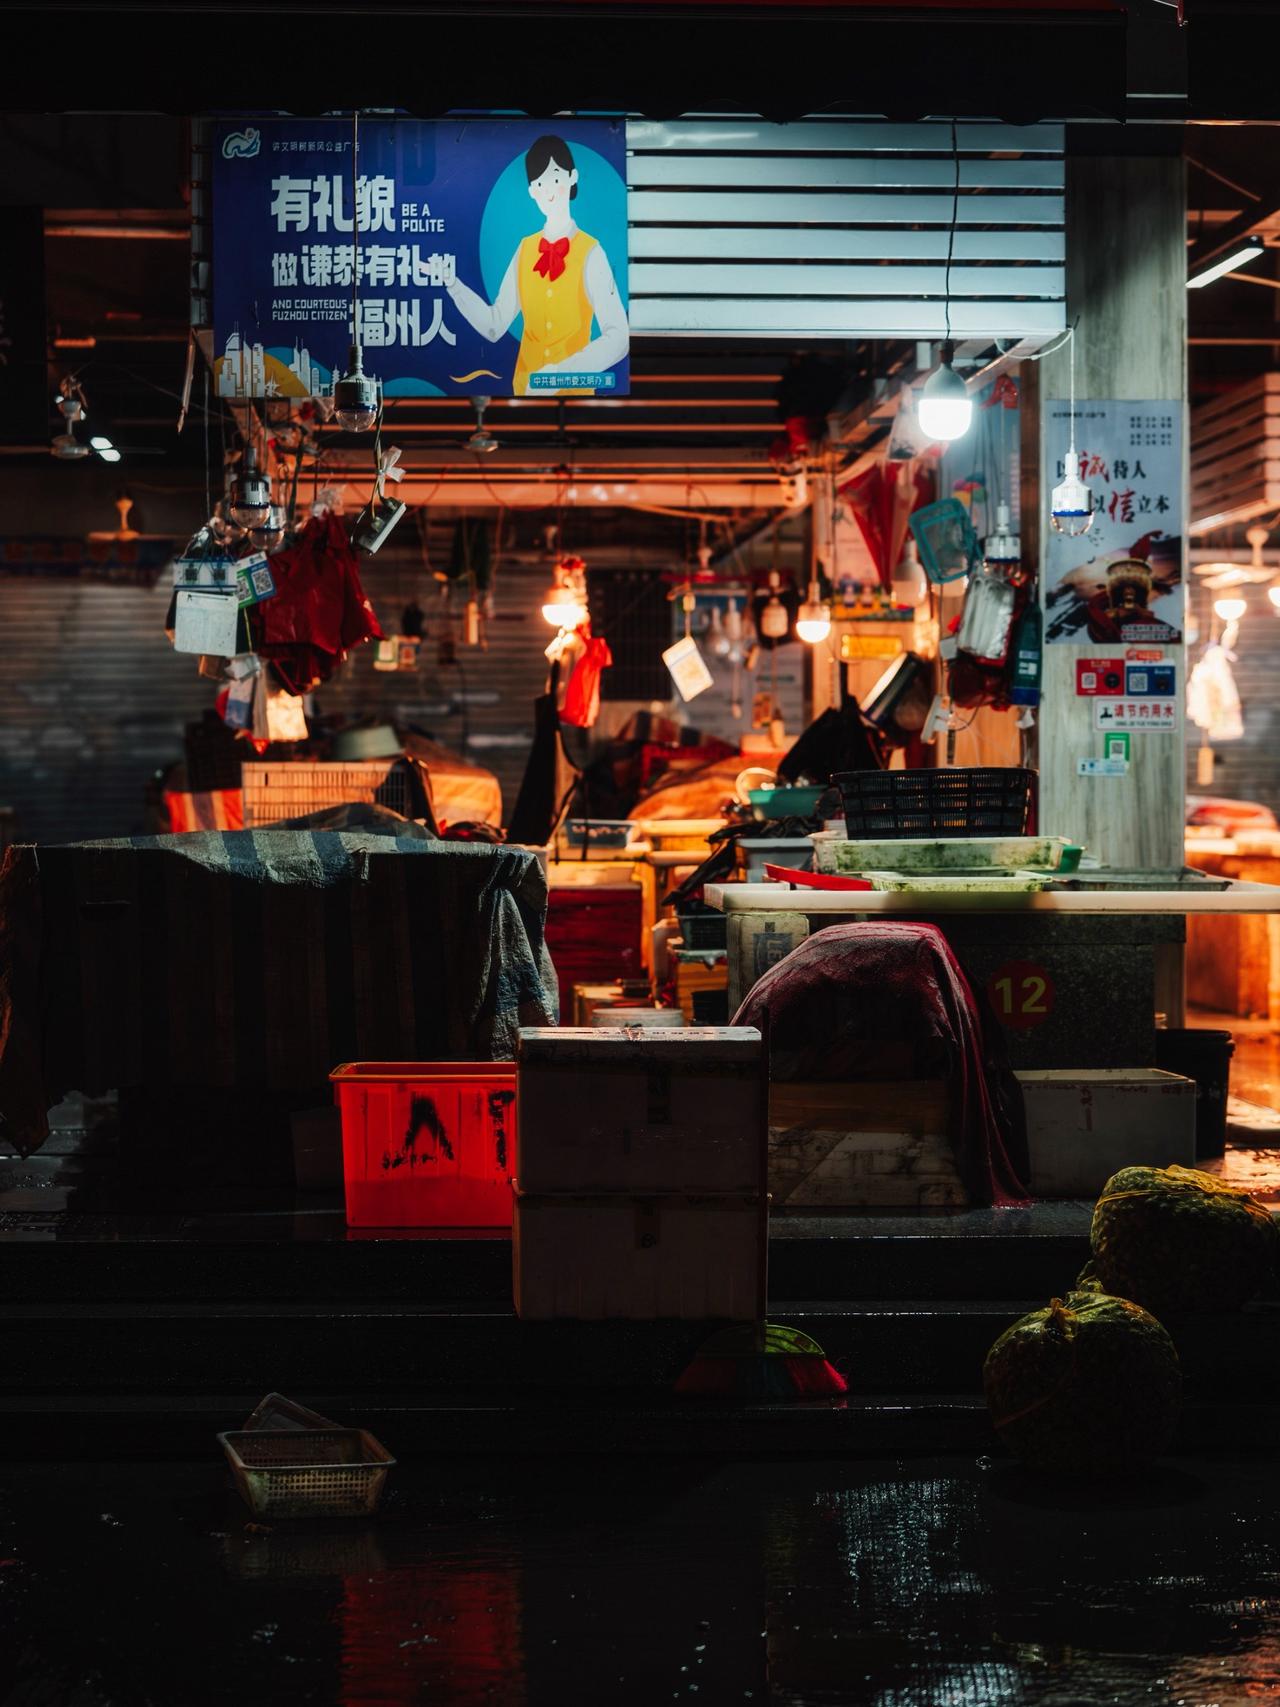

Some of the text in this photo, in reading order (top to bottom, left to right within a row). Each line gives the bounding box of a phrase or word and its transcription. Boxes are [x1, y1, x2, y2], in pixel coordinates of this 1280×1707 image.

[271, 175, 396, 232] 有礼貌
[401, 203, 431, 217] BE A
[401, 219, 445, 232] POLITE
[271, 244, 456, 287] 做谦恭有礼的
[272, 299, 347, 309] AND COURTEOUS
[272, 311, 348, 321] FUZHOU CITIZEN
[349, 298, 457, 347] 福州人
[995, 976, 1047, 1013] 12
